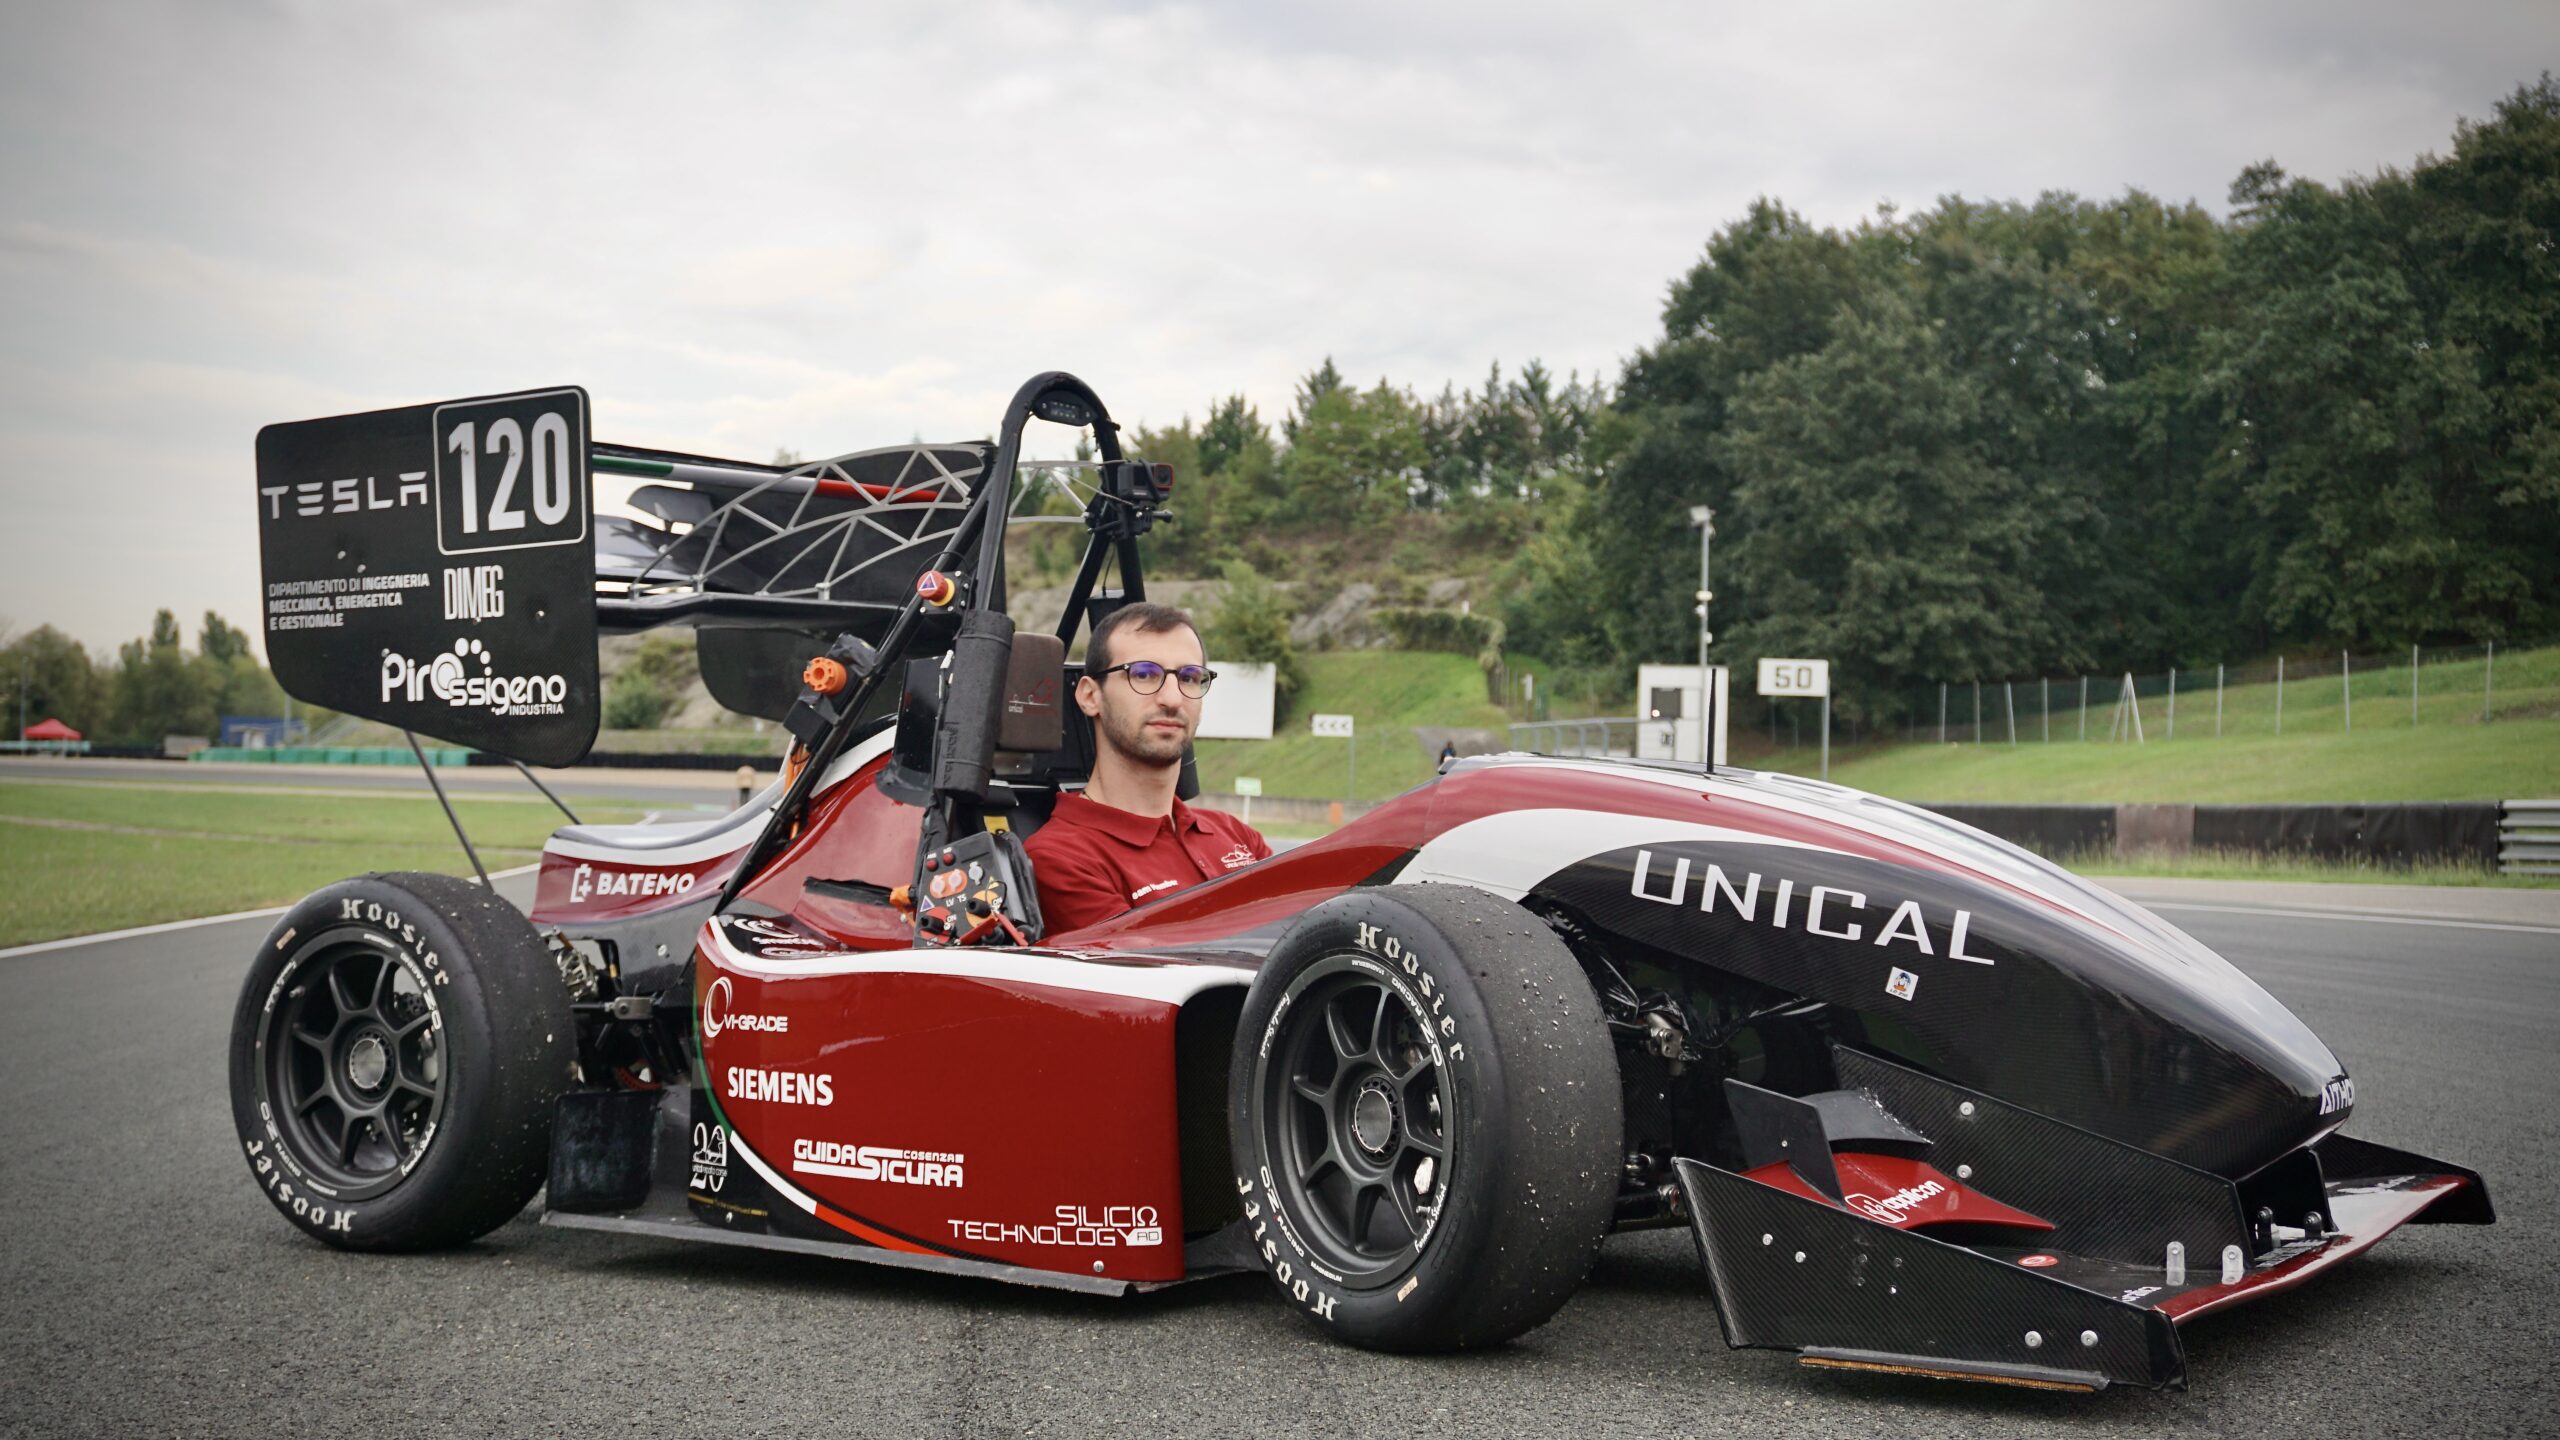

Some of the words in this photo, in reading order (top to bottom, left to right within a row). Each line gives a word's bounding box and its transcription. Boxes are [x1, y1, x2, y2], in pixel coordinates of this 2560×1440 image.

[448, 412, 570, 534] 120
[261, 471, 427, 520] TESLA
[269, 578, 347, 597] DIPARTIMENTO
[350, 578, 361, 592] DI
[362, 573, 430, 591] INGEGNERIA
[269, 597, 334, 613] MECCANICA,
[336, 592, 403, 610] ENERGETICA
[444, 565, 504, 620] DIMEG
[270, 617, 278, 631] E
[279, 613, 344, 630] GESTIONALE
[1774, 665, 1812, 690] 50
[509, 703, 564, 716] INDUSTRIA
[597, 873, 695, 895] BATEMO
[1631, 849, 1995, 965] UNICAL
[342, 898, 449, 987] Hoosier
[1355, 921, 1464, 1063] Hoosier
[1391, 977, 1423, 1016] RACING
[724, 1014, 788, 1032] VI-GRADE
[727, 1066, 834, 1107] SIEMENS
[903, 1150, 955, 1163] COSENZA
[246, 1138, 358, 1232] Hoosier
[1881, 1180, 1945, 1210] applicon
[947, 1219, 1136, 1246] TECHNOLOGY
[1237, 1177, 1341, 1321] Hoosier
[1277, 1215, 1305, 1257] RACING
